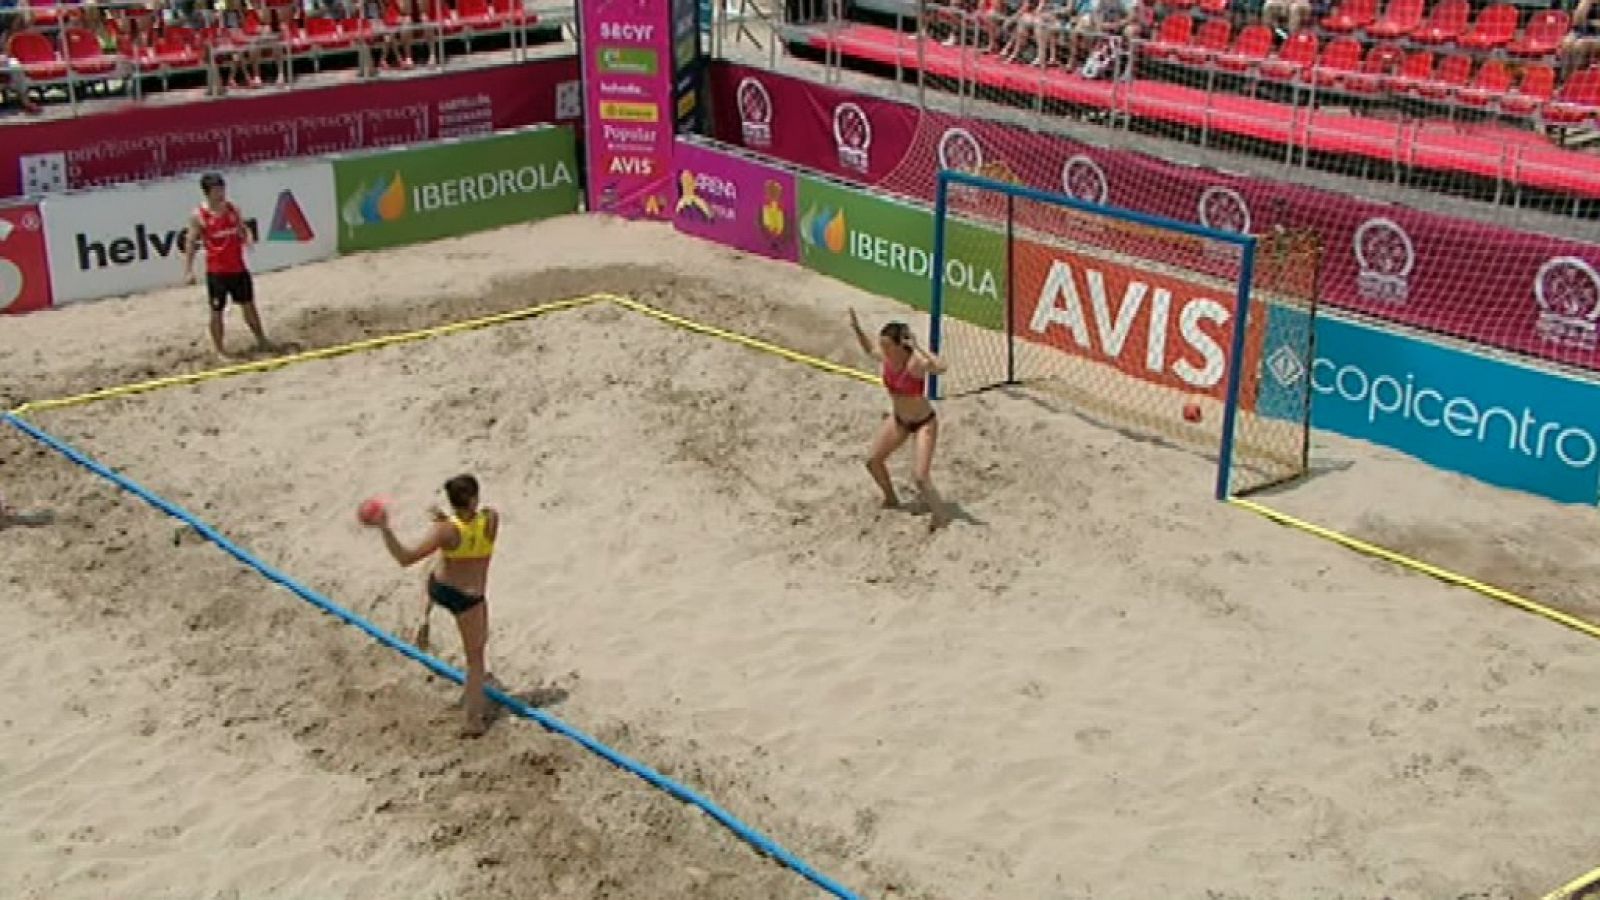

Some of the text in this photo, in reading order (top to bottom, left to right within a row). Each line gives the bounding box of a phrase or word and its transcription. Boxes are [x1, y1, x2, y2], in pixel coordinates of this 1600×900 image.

[413, 161, 572, 212] IBERDROLA
[610, 157, 652, 175] AVIS
[1030, 260, 1231, 388] AVIS
[1311, 358, 1597, 467] copicentro
